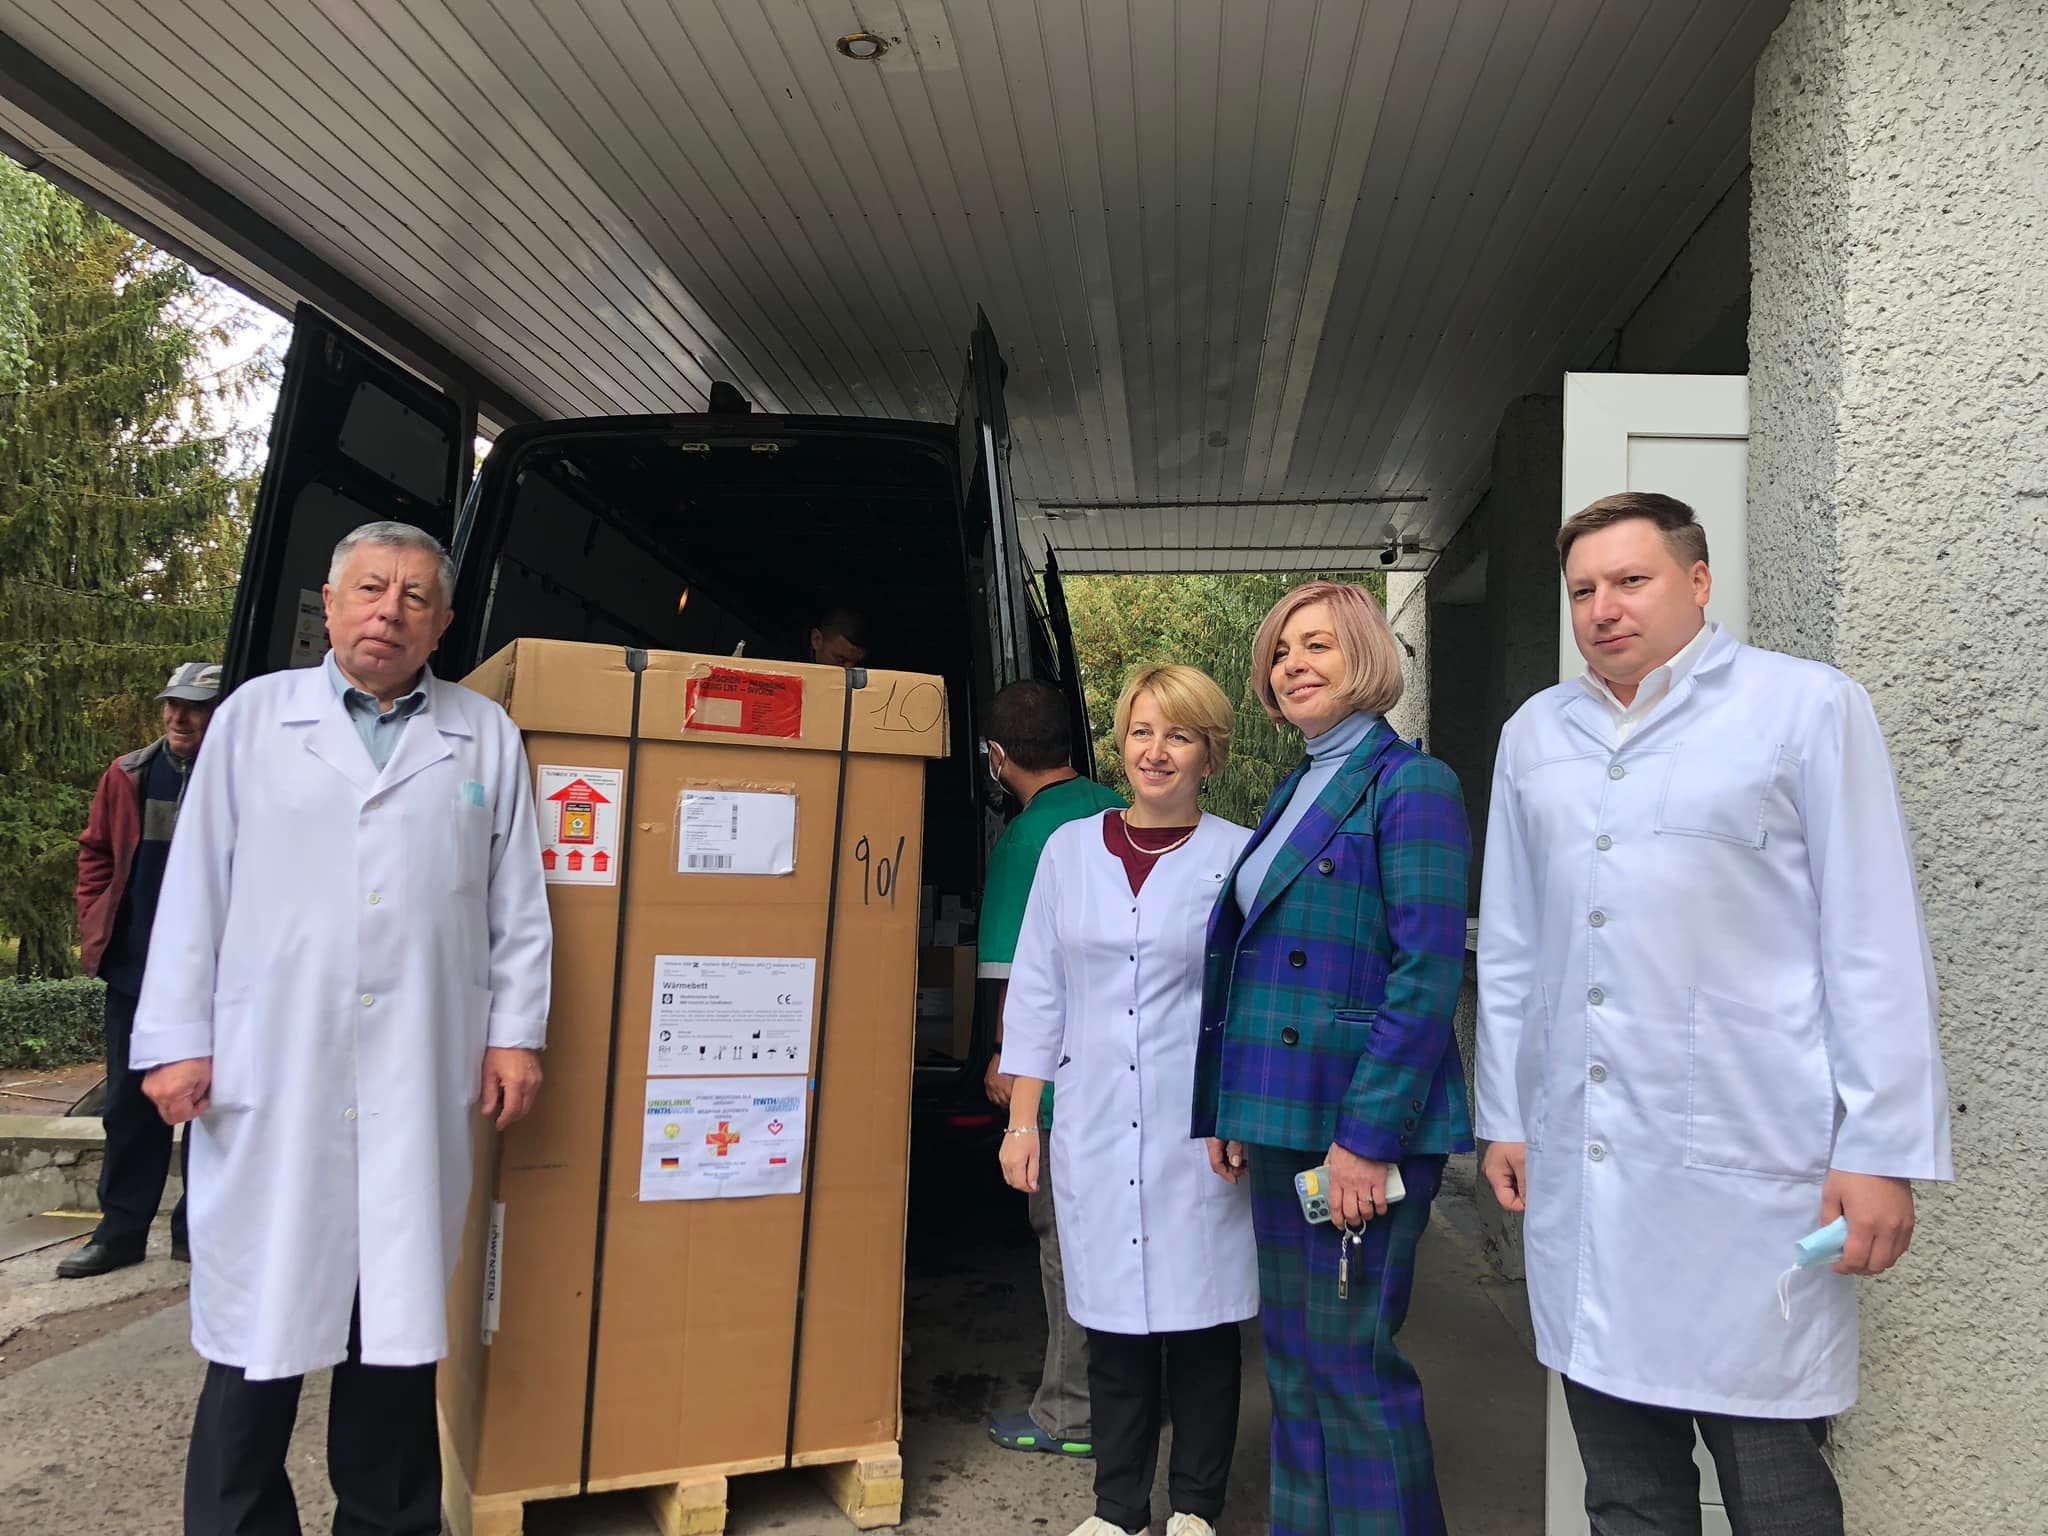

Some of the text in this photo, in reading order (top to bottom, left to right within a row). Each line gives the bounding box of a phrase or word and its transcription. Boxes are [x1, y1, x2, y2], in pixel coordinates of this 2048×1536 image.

[869, 679, 943, 733] 10
[662, 981, 708, 990] Wärmebett
[777, 994, 791, 1005] CE
[648, 1098, 692, 1107] UNIKLINIK
[487, 1224, 500, 1301] LÖWENSTEIN
